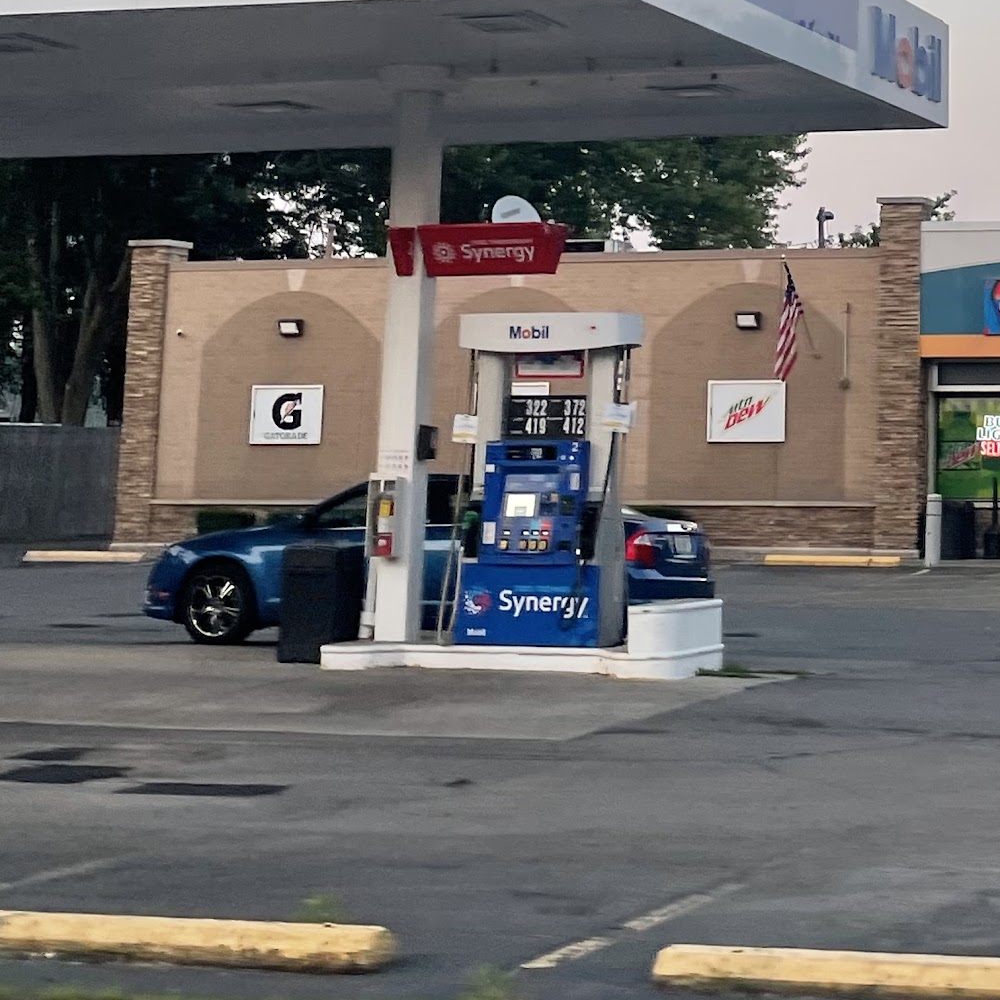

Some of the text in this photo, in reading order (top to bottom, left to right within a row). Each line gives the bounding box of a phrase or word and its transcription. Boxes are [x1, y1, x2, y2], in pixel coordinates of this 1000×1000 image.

[461, 244, 534, 262] Synergy
[509, 326, 549, 339] Mobil
[272, 392, 302, 430] G
[526, 399, 548, 416] 322
[564, 399, 586, 416] 372
[525, 417, 546, 434] 419
[563, 417, 584, 434] 412
[572, 442, 578, 452] 2
[499, 589, 588, 618] Synergy
